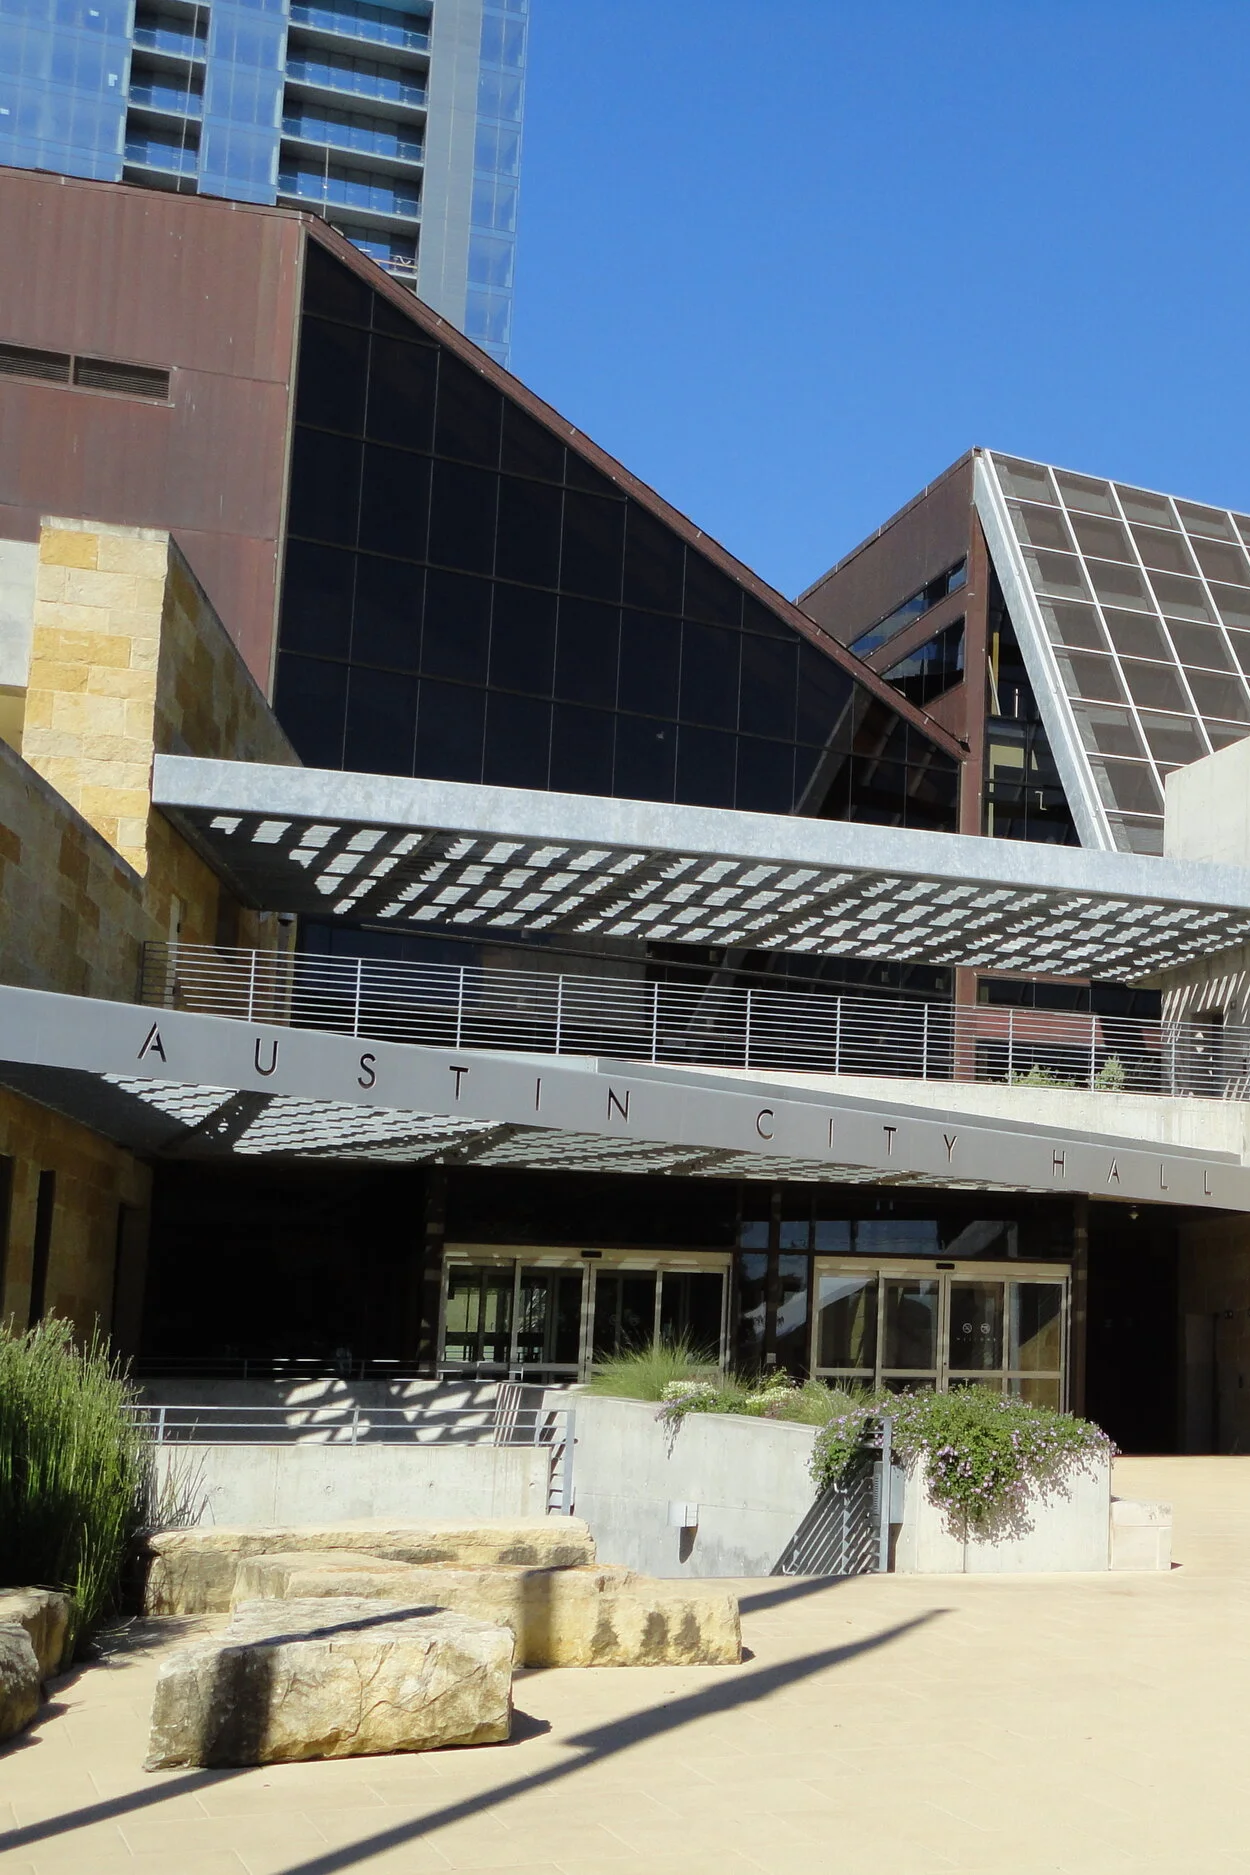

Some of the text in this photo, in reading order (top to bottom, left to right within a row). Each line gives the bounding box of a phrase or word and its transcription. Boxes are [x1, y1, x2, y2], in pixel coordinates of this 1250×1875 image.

[137, 1021, 1212, 1196] AUSTIN CITY HALL
